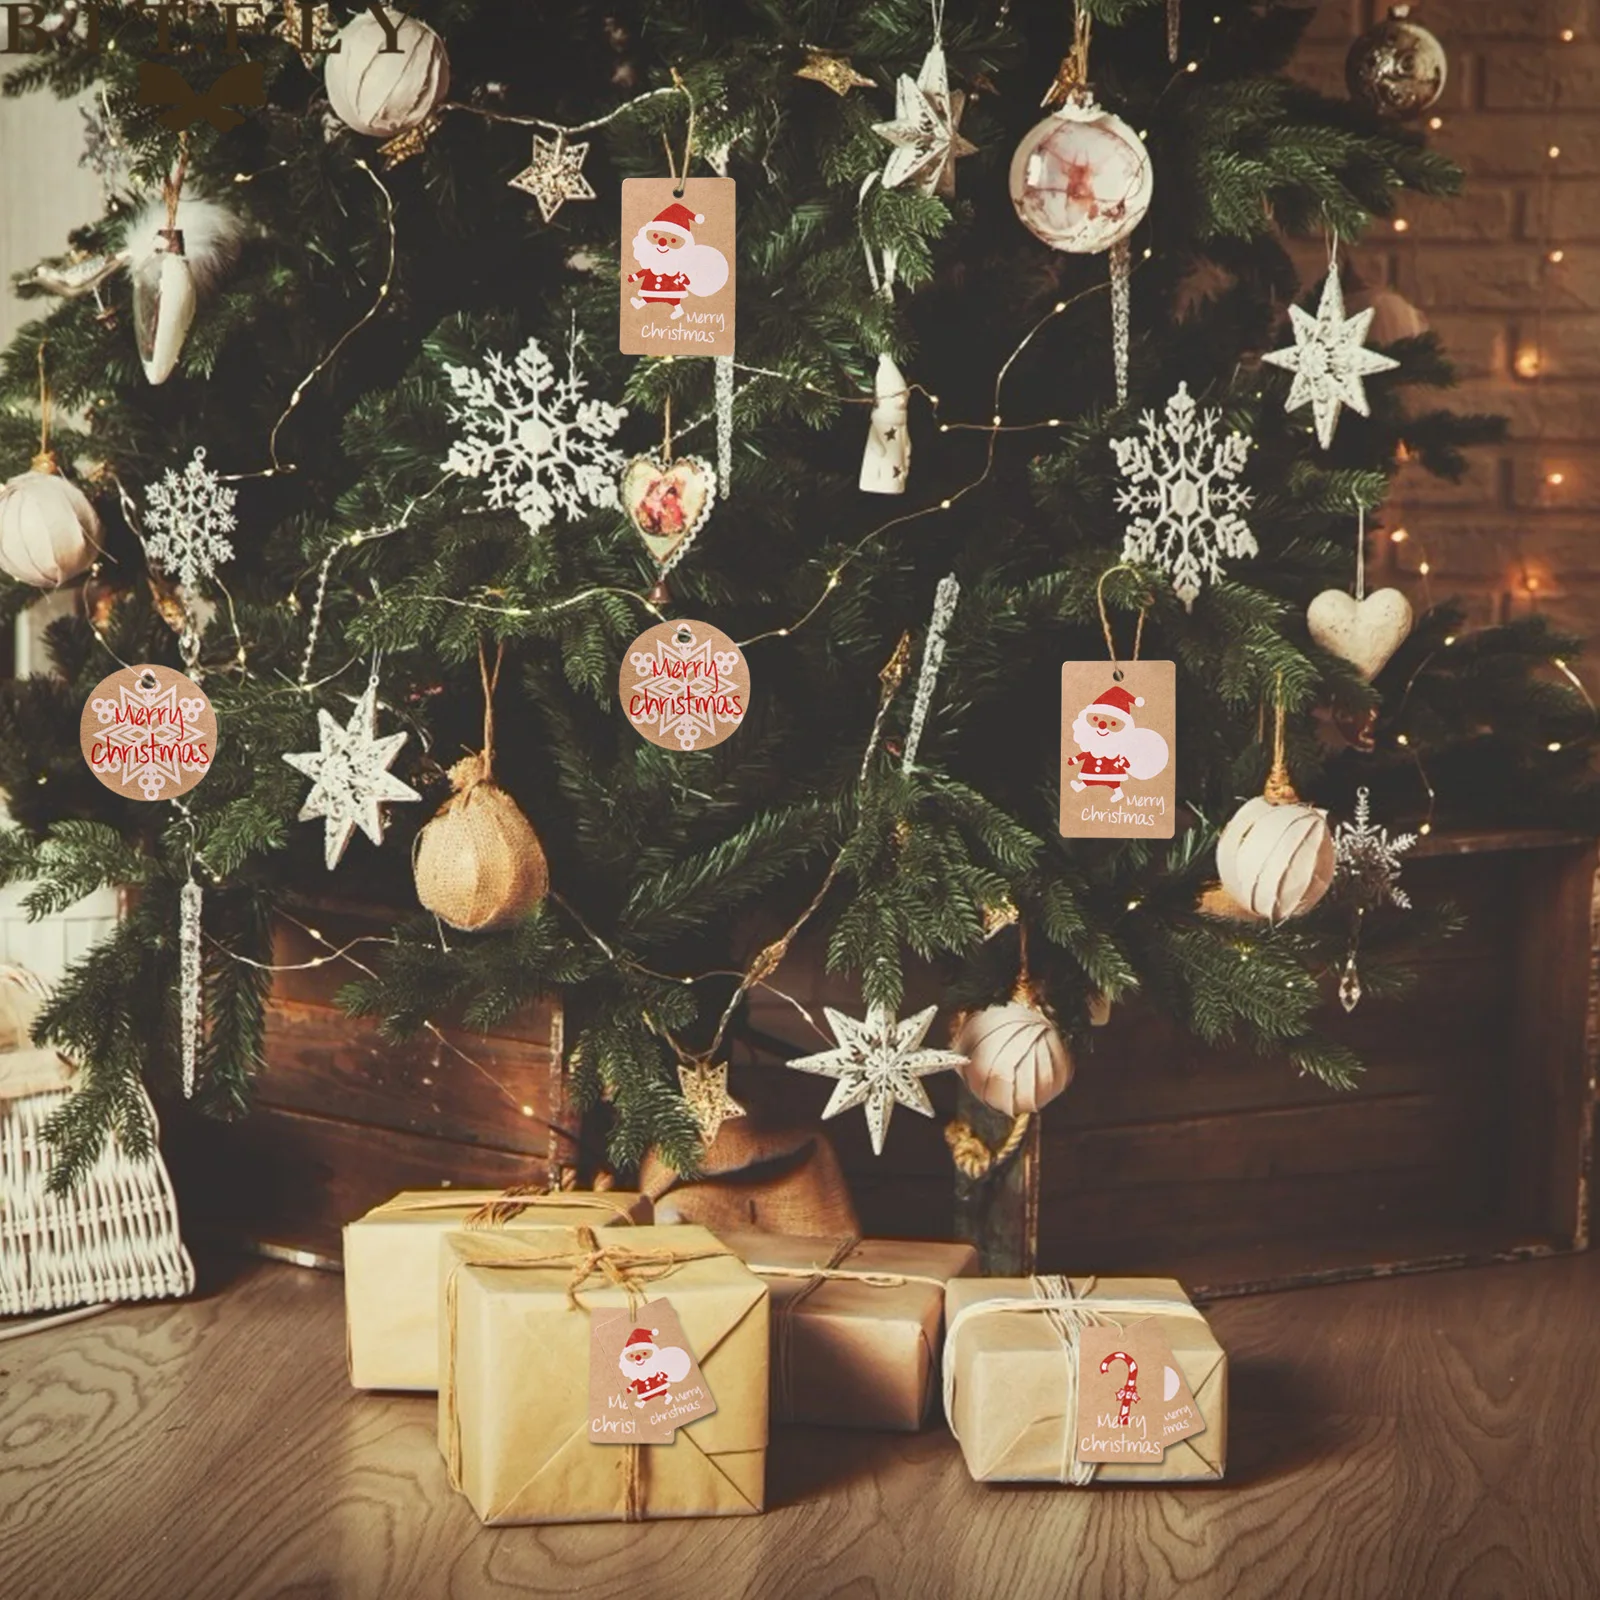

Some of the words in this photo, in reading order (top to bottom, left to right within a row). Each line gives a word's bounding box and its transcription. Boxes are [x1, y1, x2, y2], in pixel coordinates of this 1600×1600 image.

[686, 311, 725, 332] Merry
[652, 657, 719, 693] Merry
[115, 704, 184, 742] Merry
[1126, 795, 1165, 815] Merry
[674, 1386, 704, 1402] Merry
[1097, 1413, 1147, 1440] Merry
